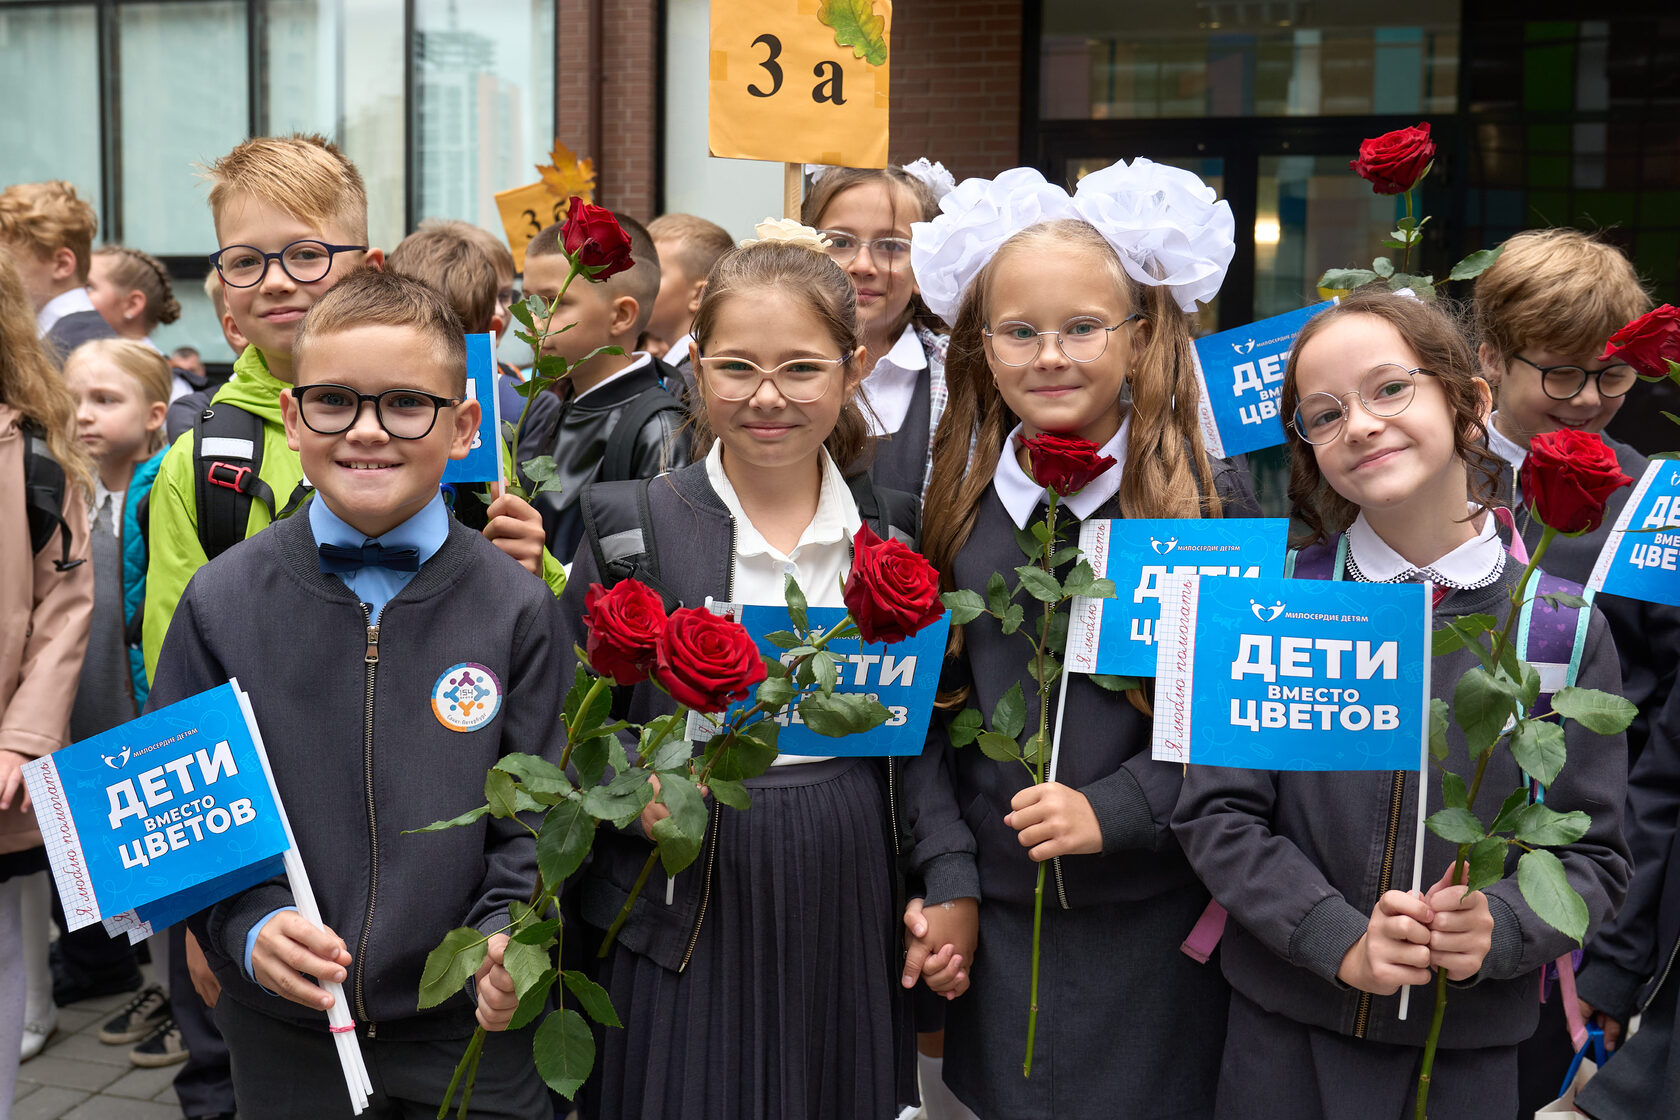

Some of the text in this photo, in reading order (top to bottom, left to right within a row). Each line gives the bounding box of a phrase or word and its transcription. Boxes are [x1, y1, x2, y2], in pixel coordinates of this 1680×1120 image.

[747, 33, 847, 106] 3 а
[521, 208, 542, 239] 3
[1284, 611, 1369, 623] МИЛОСЕРДИЕ ДЕТЯМ
[1166, 677, 1186, 738] люблю
[1177, 578, 1193, 673] помогать
[1230, 633, 1399, 683] ДЕТИ
[1230, 698, 1401, 733] ЦВЕТОВ
[1267, 685, 1361, 703] ВМЕСТО
[133, 727, 198, 758] МИЛОСЕРДИЕ ДЕТЯМ
[40, 761, 73, 844] помогать
[105, 740, 239, 830] ДЕТИ
[118, 797, 257, 870] ЦВЕТОВ
[144, 795, 216, 832] ВМЕСТО
[62, 849, 89, 902] люблю
